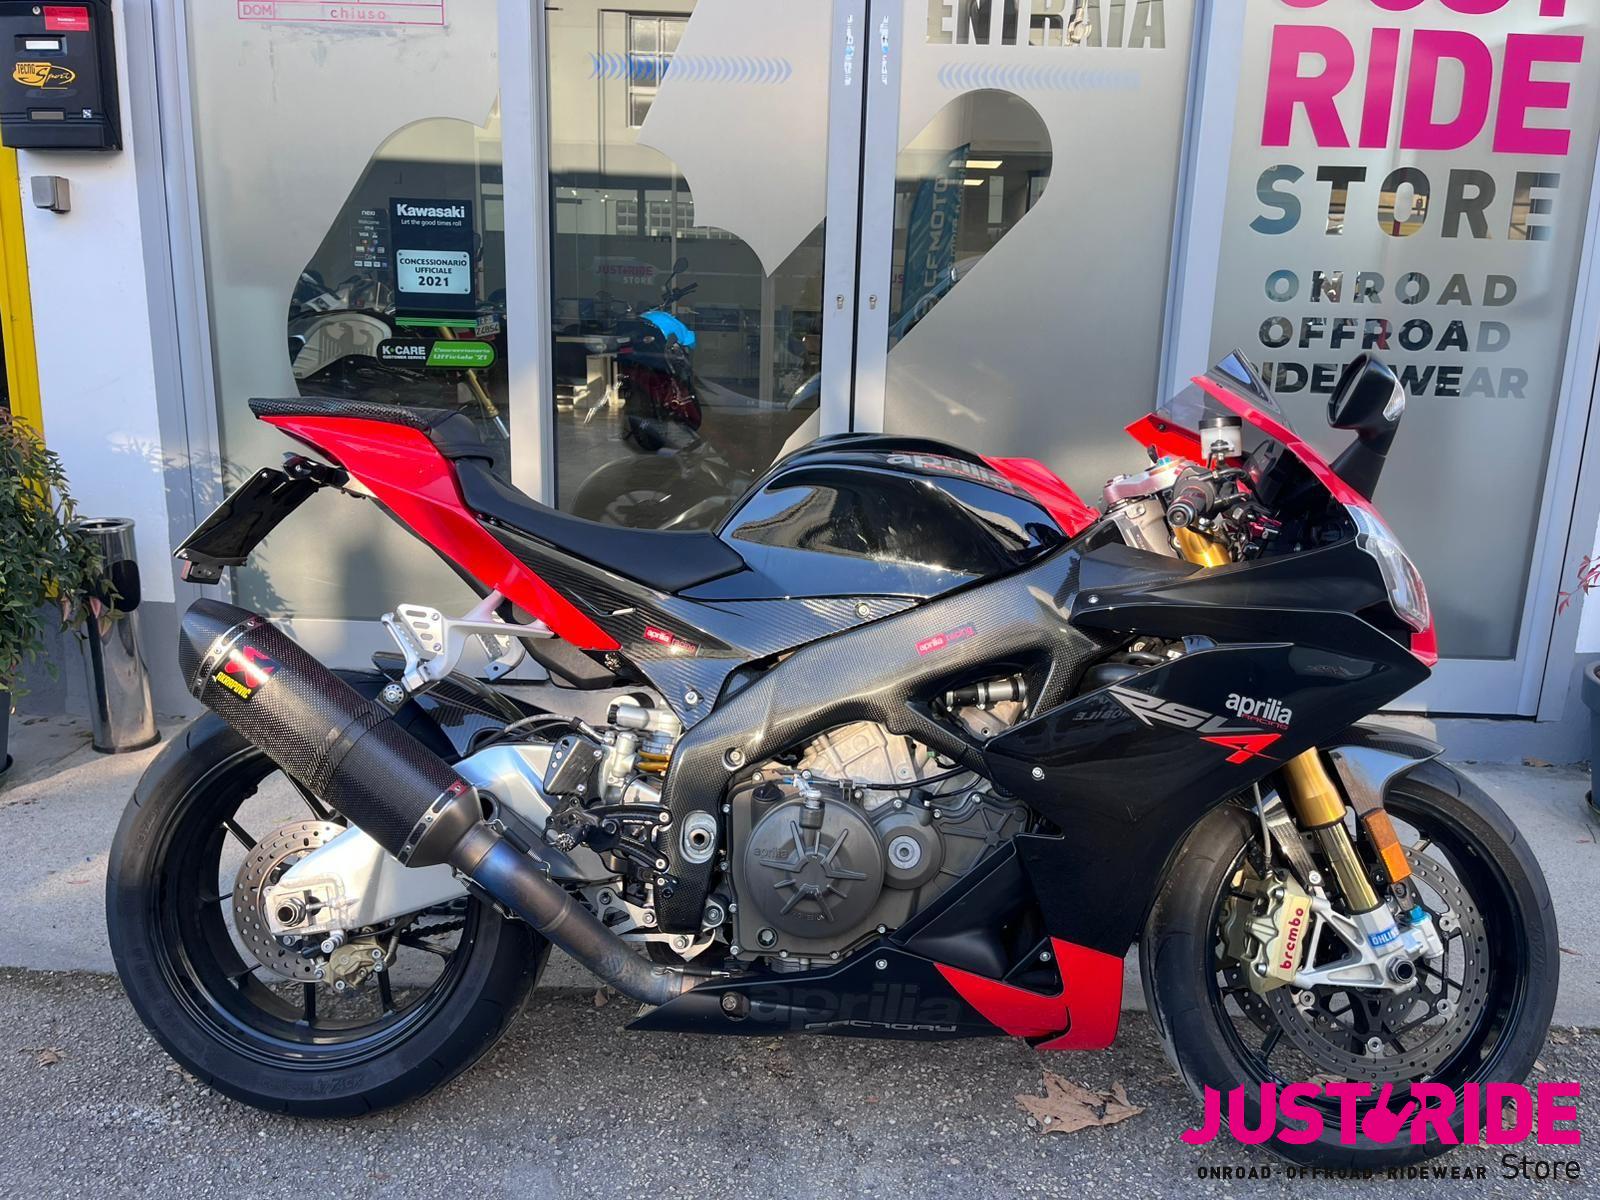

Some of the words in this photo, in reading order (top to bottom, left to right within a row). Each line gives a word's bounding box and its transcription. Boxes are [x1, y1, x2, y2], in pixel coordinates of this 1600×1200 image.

[242, 4, 273, 16] DOM
[330, 9, 387, 20] chiuso
[1261, 24, 1585, 155] RIDE
[396, 203, 465, 219] Kawasaki
[1249, 164, 1561, 241] STORE
[422, 219, 436, 227] good
[924, 174, 947, 287] CFMOTO
[399, 257, 467, 266] CONCESSIONARIO
[415, 266, 452, 274] UFFICIALE
[418, 276, 449, 287] 2021
[623, 276, 653, 285] STORE
[1264, 269, 1518, 307] ONROAD
[1258, 316, 1511, 353] OFFROAD
[886, 453, 1013, 489] aprilia
[646, 628, 670, 643] aprilia
[919, 636, 943, 652] aprilia
[1225, 692, 1293, 725] aprilia
[1280, 907, 1304, 970] brembo
[750, 983, 963, 1031] aprilia
